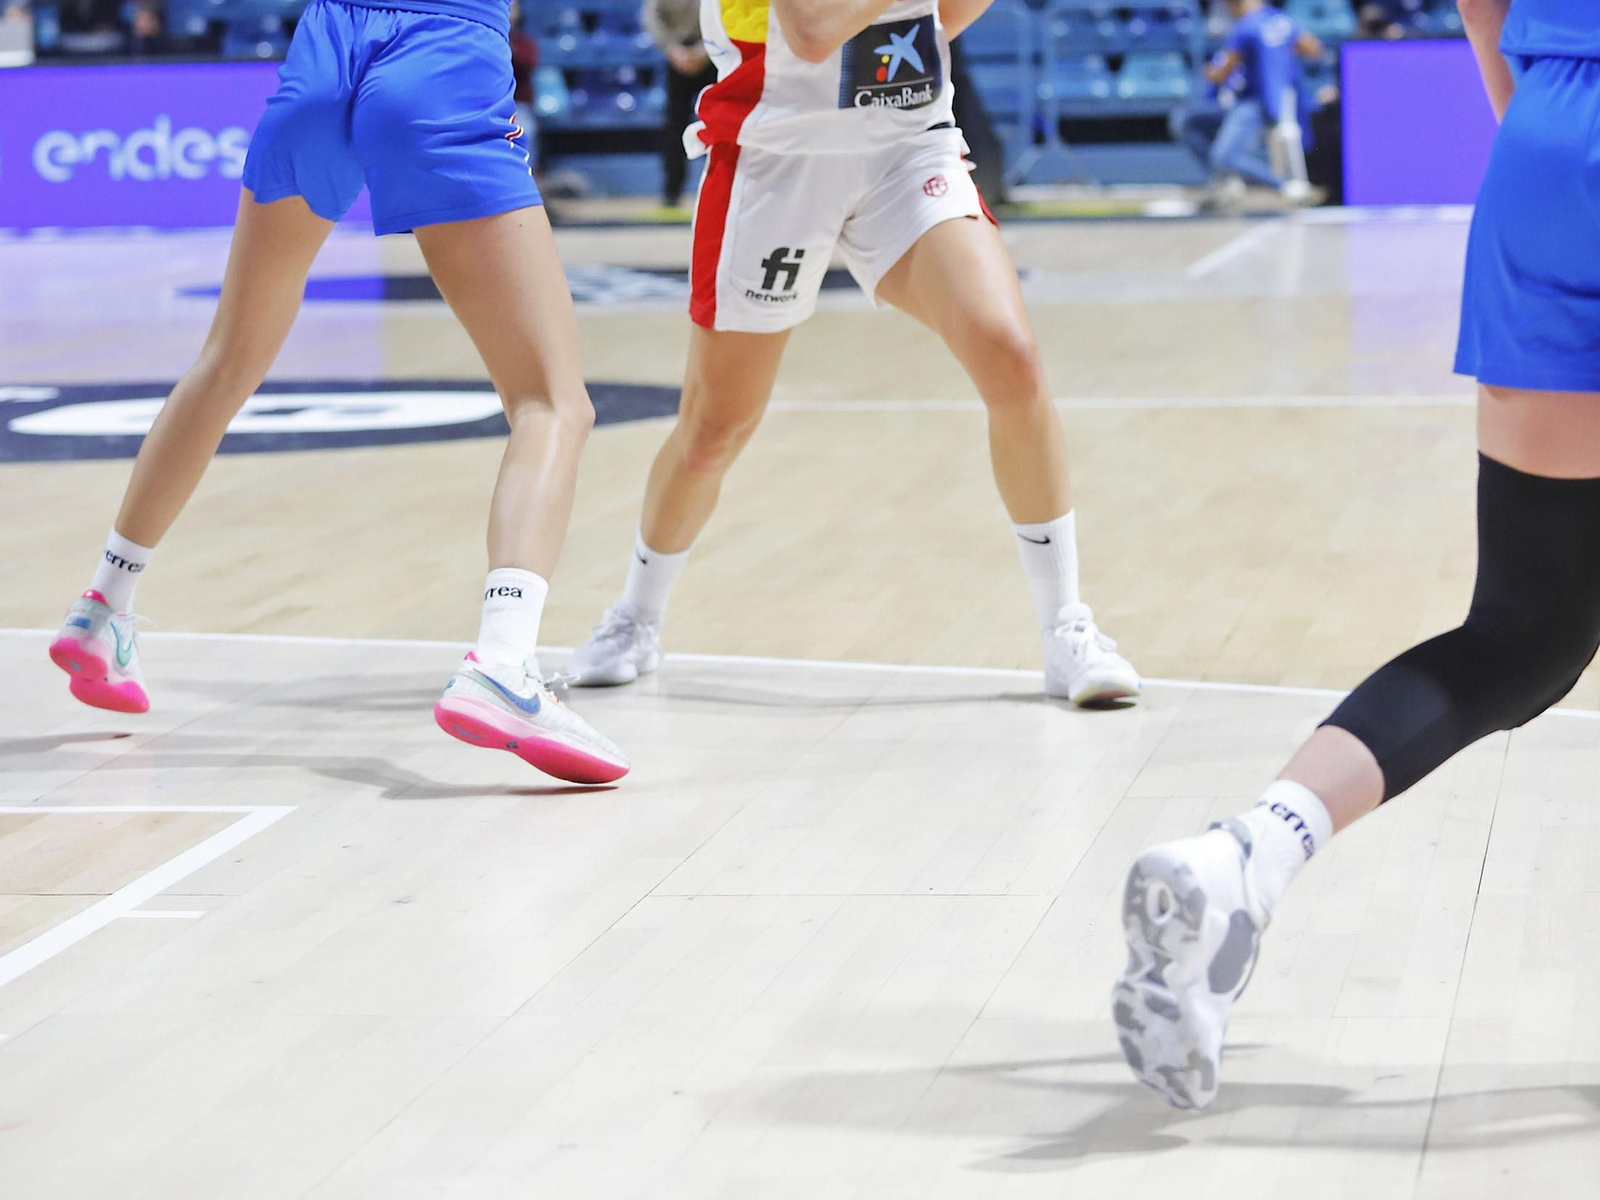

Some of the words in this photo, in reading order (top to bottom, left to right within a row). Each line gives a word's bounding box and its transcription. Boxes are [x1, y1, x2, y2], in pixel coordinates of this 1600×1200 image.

[854, 83, 933, 109] CaixaBank
[32, 113, 248, 183] endes
[761, 247, 805, 291] fi
